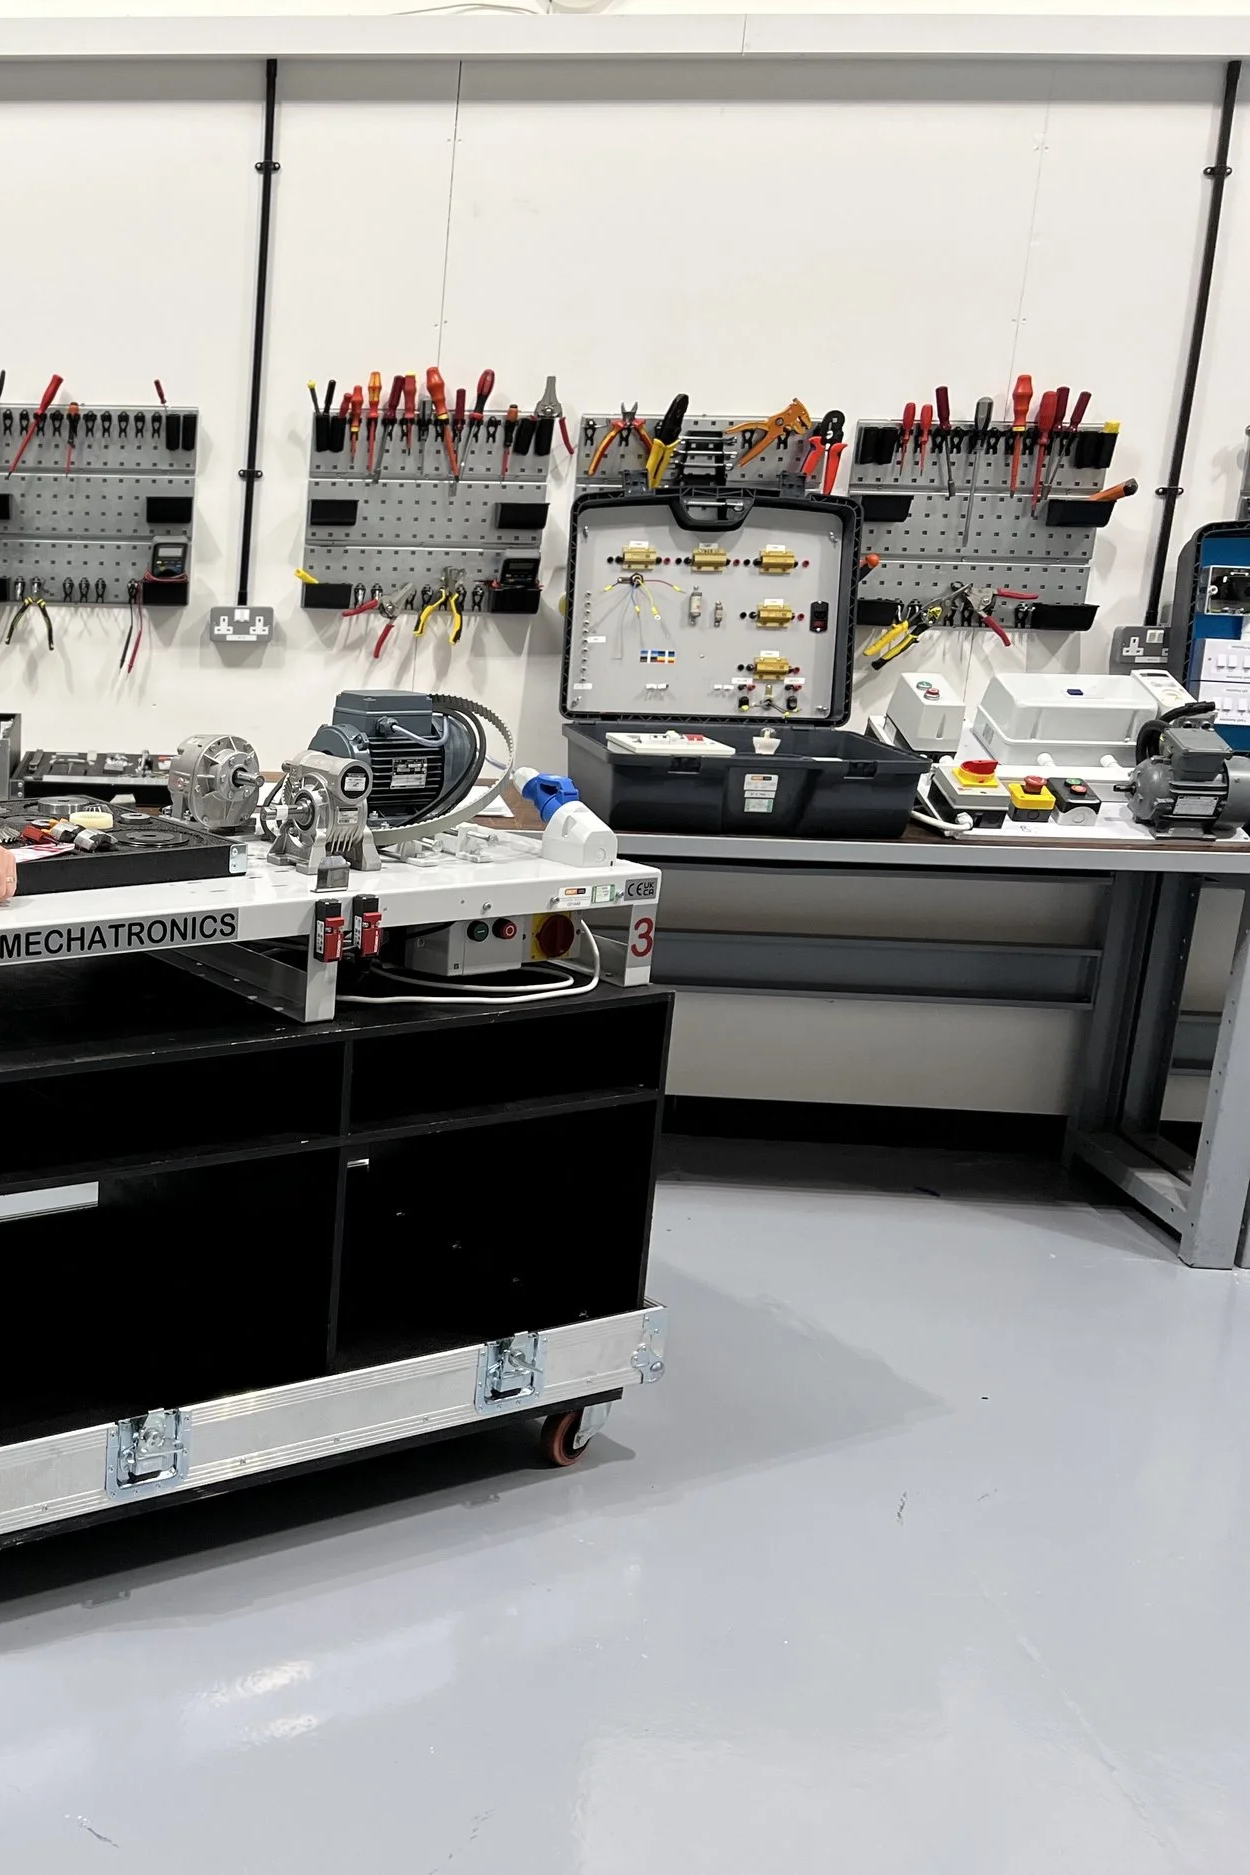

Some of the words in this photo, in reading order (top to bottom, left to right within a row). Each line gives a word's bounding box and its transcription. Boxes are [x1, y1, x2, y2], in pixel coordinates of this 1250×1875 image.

[628, 882, 643, 897] CE
[0, 913, 236, 959] MECHATRONICS
[631, 917, 654, 958] 3
